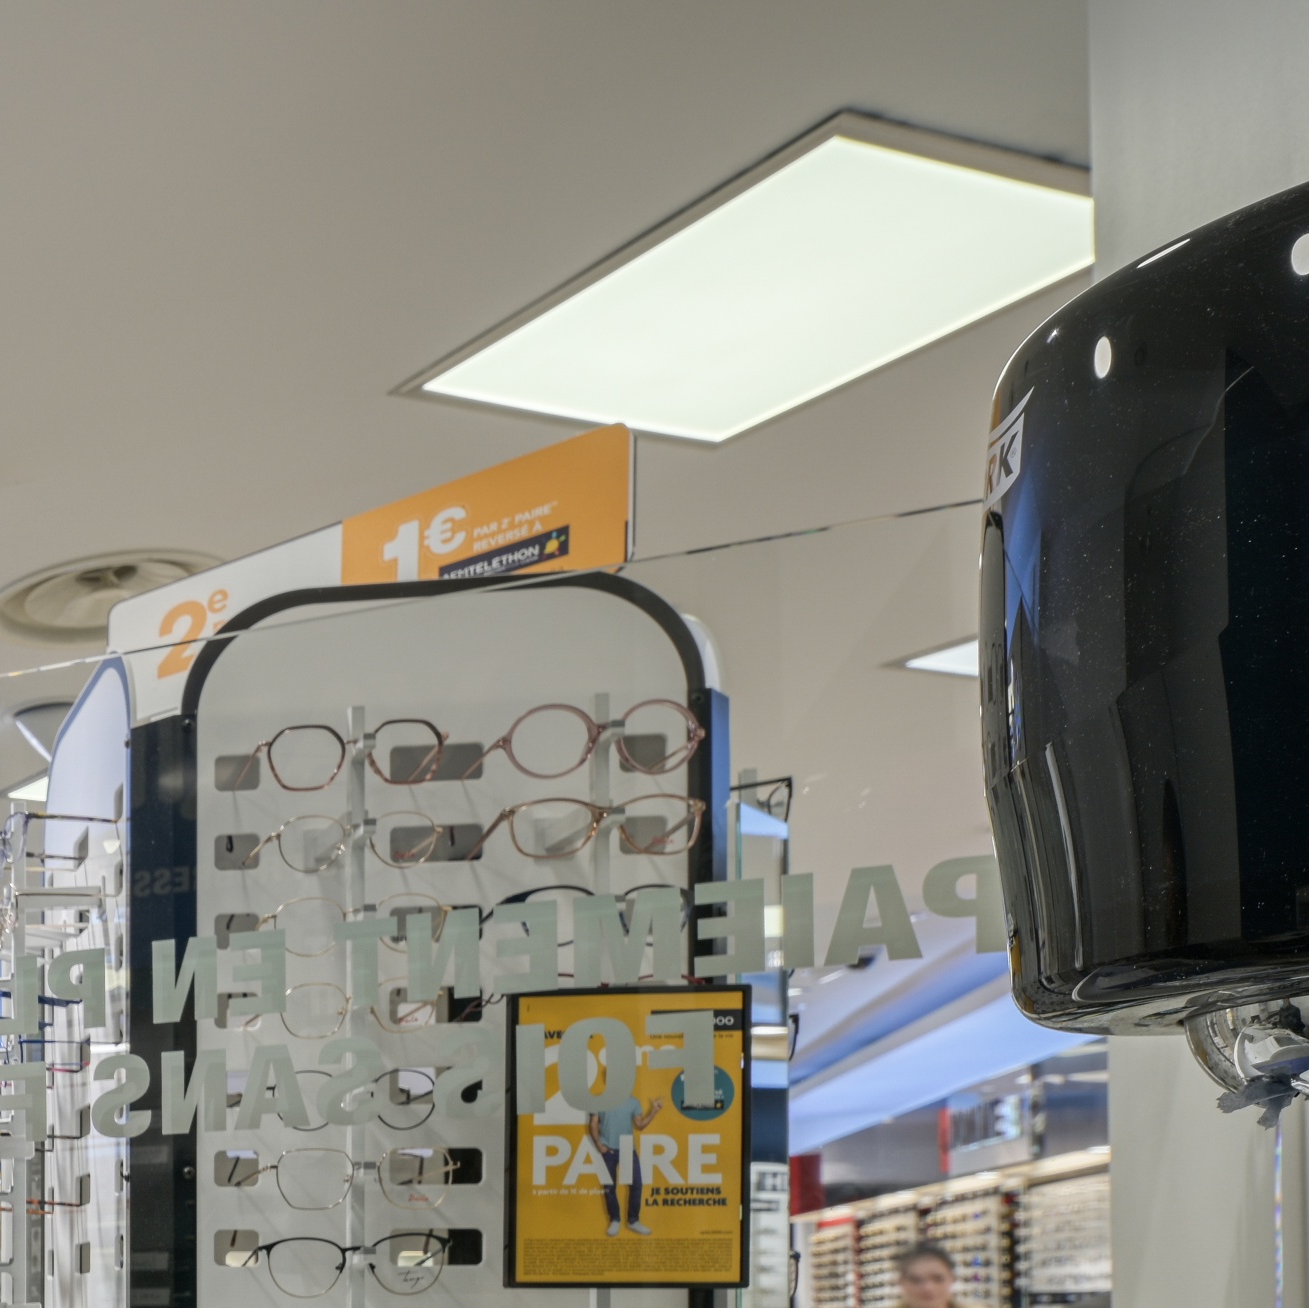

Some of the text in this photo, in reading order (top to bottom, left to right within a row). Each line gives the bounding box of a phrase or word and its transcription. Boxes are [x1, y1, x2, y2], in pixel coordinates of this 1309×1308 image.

[473, 521, 499, 539] PAR
[533, 1132, 723, 1186] PAIRE
[650, 1186, 722, 1197] JE SOUTIENS
[645, 1197, 728, 1207] LA RECHERCHE
